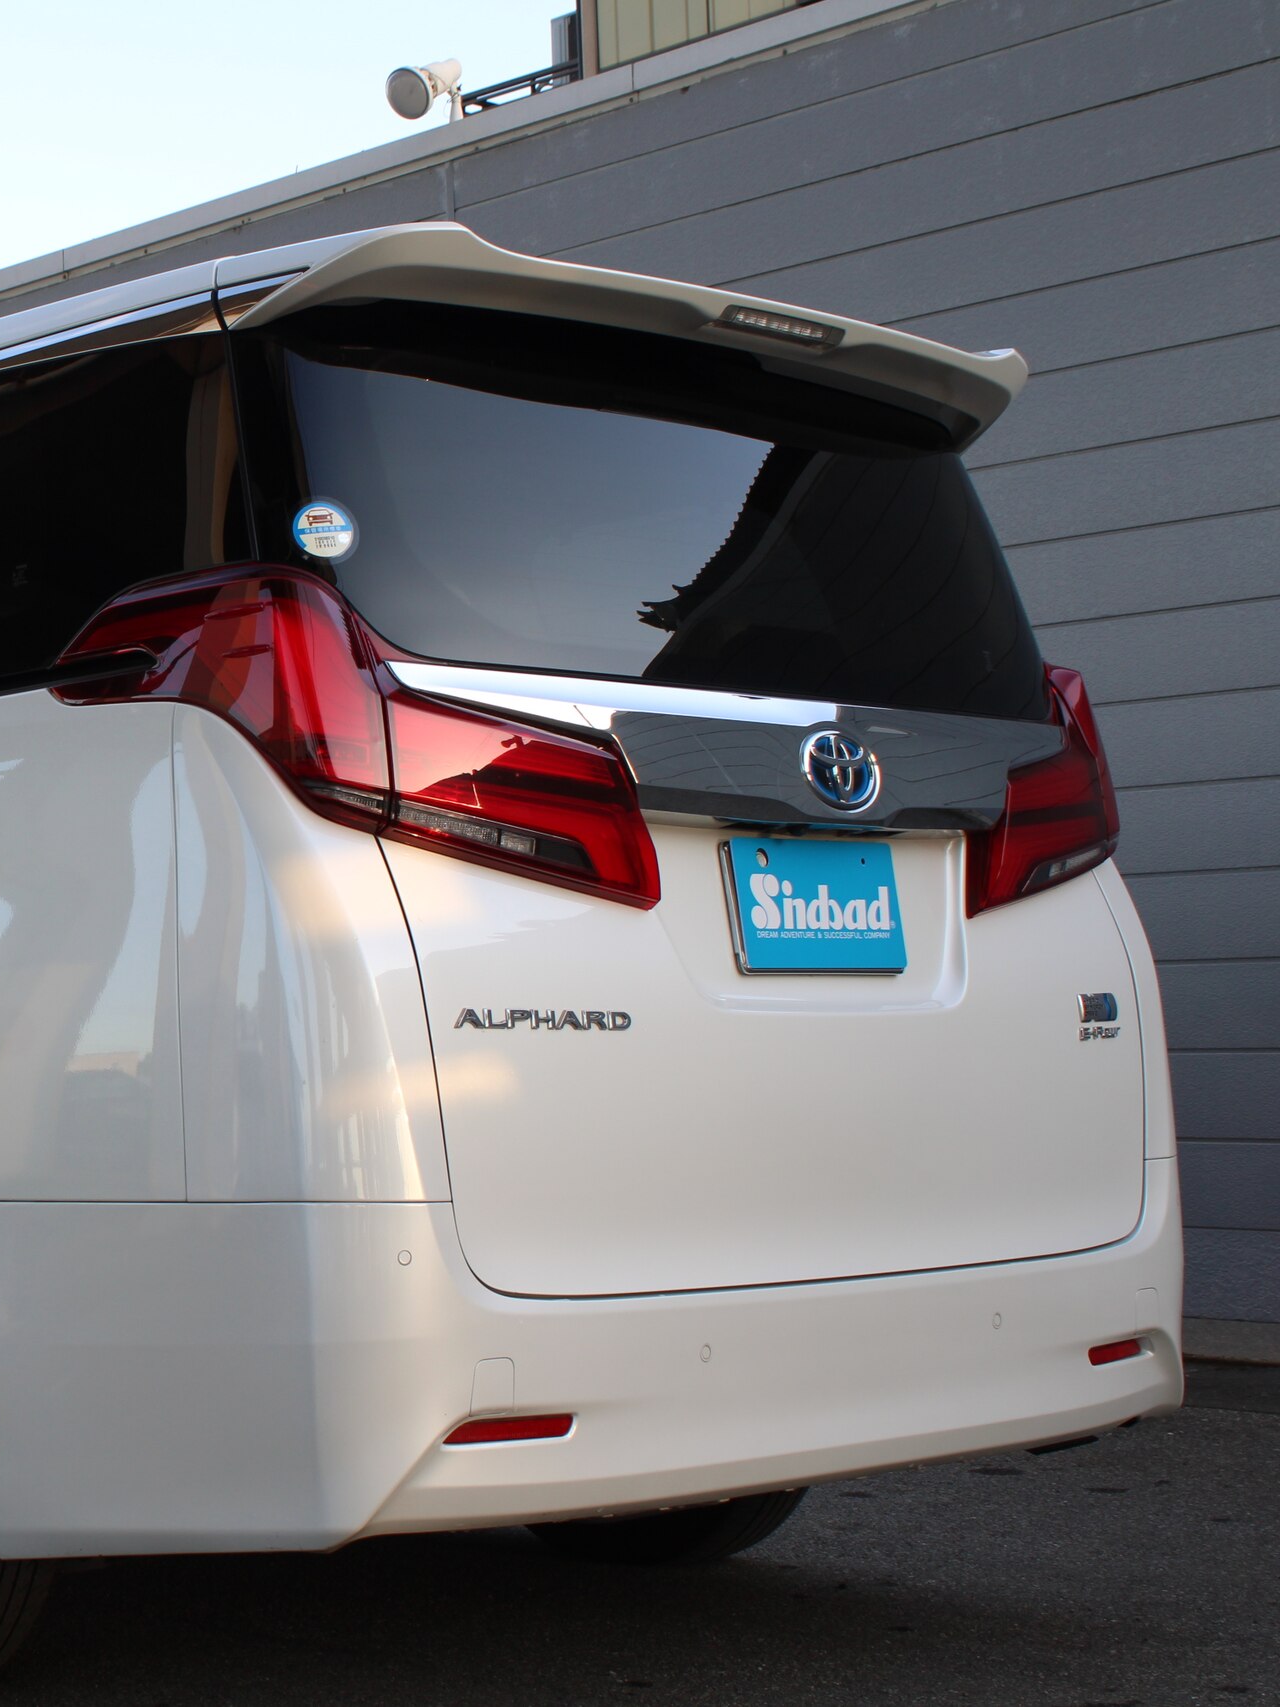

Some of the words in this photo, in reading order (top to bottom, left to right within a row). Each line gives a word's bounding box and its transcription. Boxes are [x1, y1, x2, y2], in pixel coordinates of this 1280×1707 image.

[756, 931, 779, 939] DREAM
[780, 931, 816, 939] ADVENTURE
[824, 931, 863, 939] SUCCESSFUL
[863, 931, 891, 939] COMPANY
[453, 1007, 632, 1031] ALPHARD
